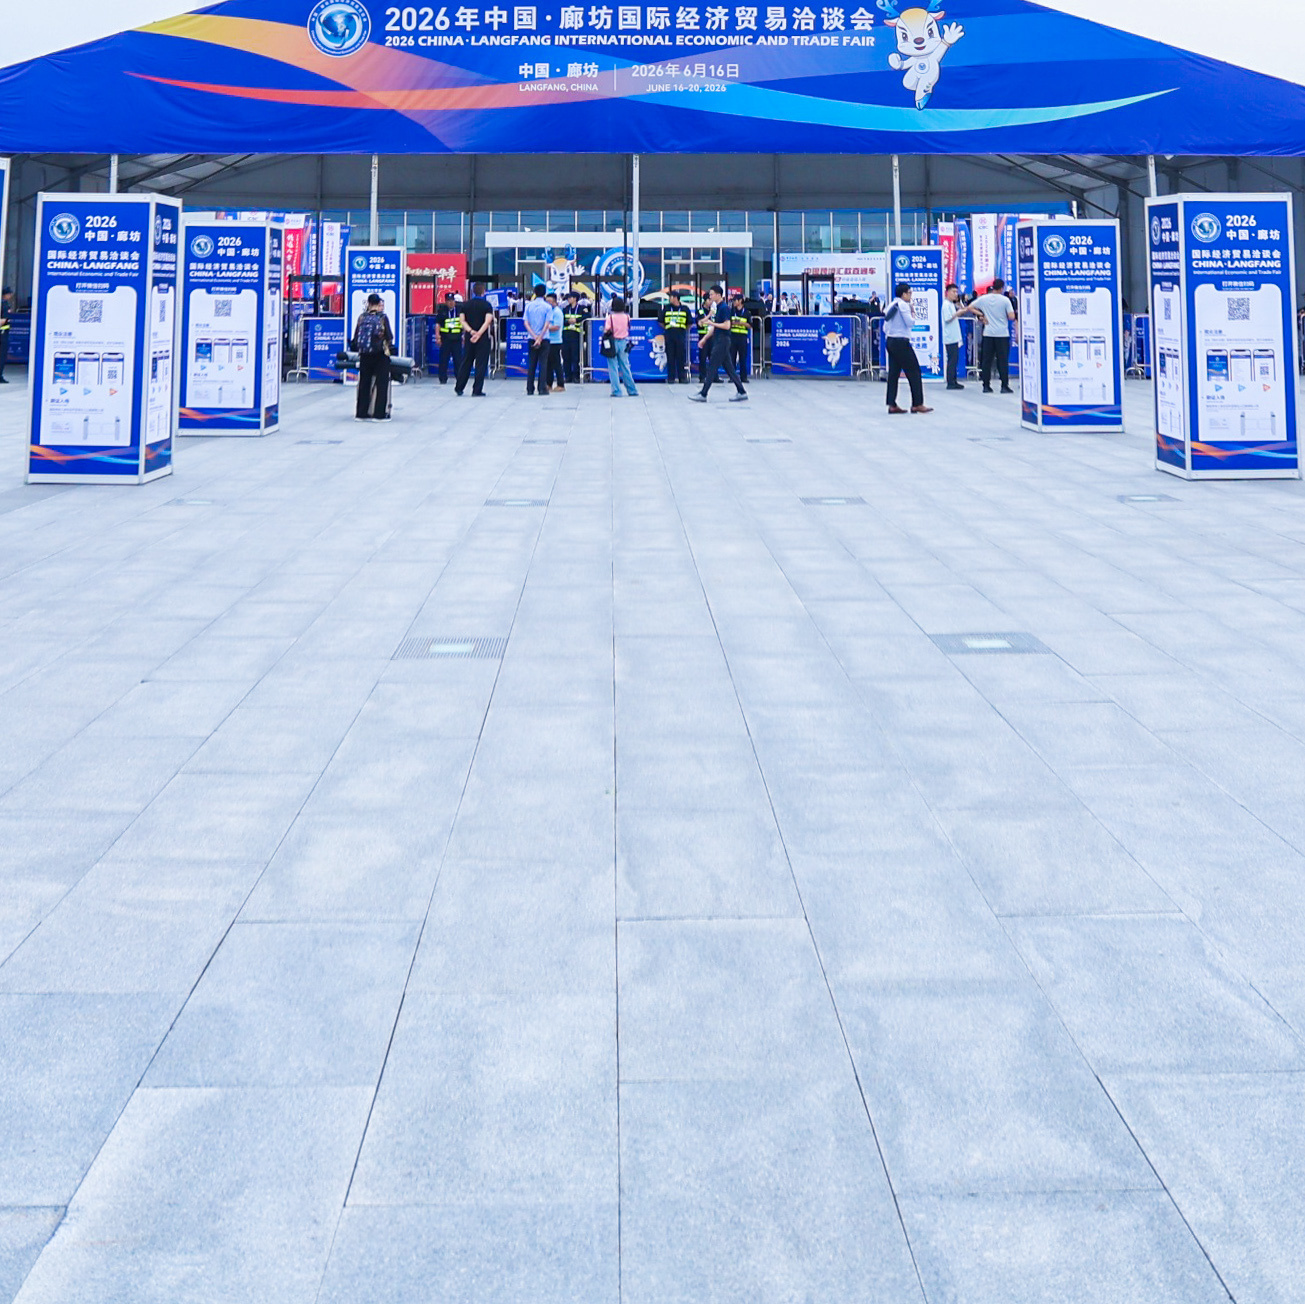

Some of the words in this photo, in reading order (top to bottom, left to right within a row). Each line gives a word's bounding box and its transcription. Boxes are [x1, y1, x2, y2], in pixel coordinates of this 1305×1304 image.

[385, 5, 875, 31] 2026年中国·廊坊国际经济贸易洽谈会
[385, 36, 415, 46] 2026
[418, 35, 551, 46] CHINA·LANGFANG
[554, 35, 672, 46] INTERNATIONAL
[676, 35, 754, 46] ECONOMIC
[756, 35, 788, 46] AND
[792, 35, 838, 46] TRADE
[845, 35, 875, 46] FAIR
[631, 63, 740, 78] 2026年6月16日
[519, 84, 569, 92] LANGFANG,
[646, 84, 671, 92] JUNE
[673, 84, 702, 93] 16-20,
[704, 84, 727, 92] 2026
[85, 215, 117, 227] 2026
[1226, 215, 1256, 226] 2026
[218, 237, 241, 245] 2026
[1069, 236, 1092, 244] 2026
